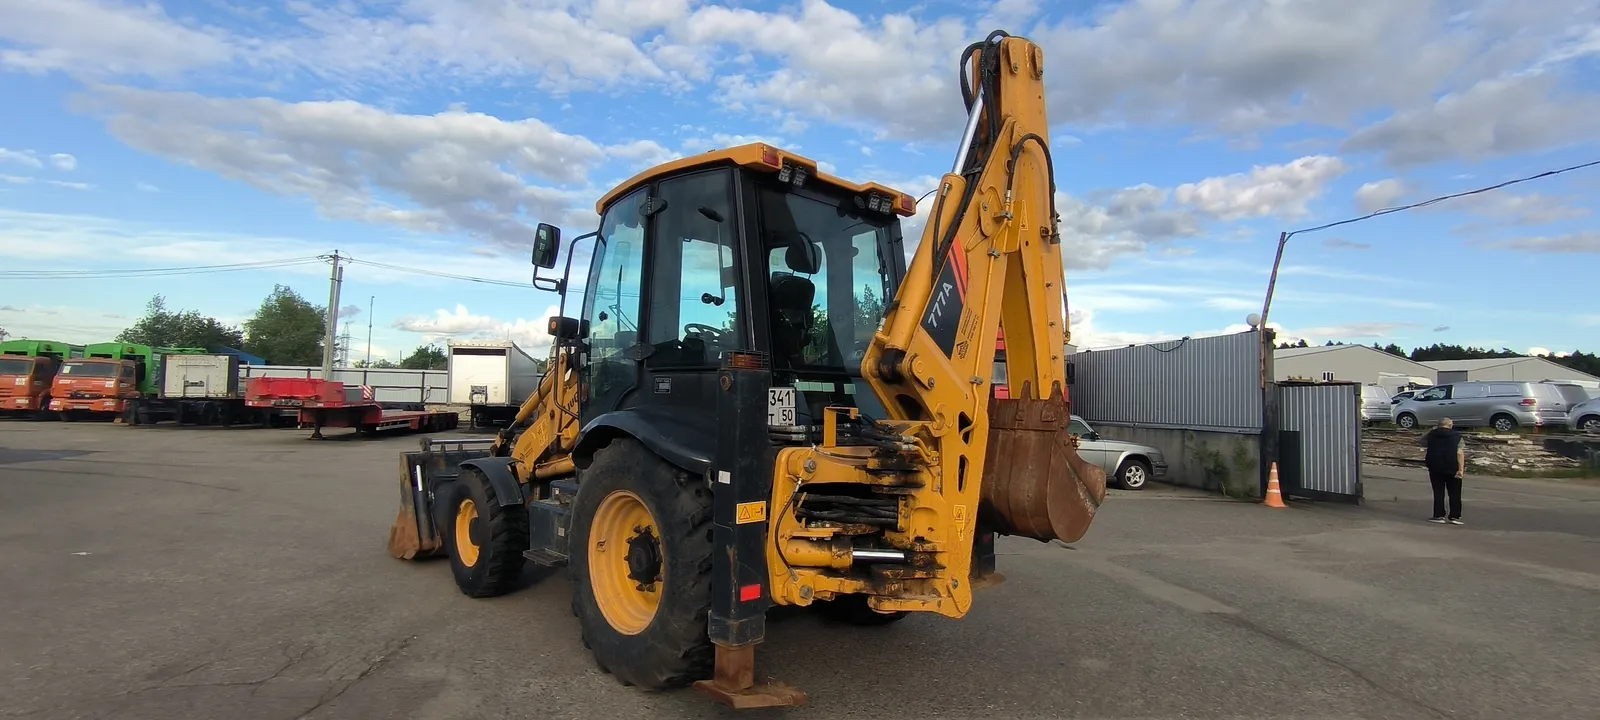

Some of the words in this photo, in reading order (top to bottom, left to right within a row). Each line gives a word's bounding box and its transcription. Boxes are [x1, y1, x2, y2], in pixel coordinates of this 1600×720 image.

[928, 282, 953, 328] 777A
[769, 389, 791, 406] 341
[782, 409, 793, 421] 50
